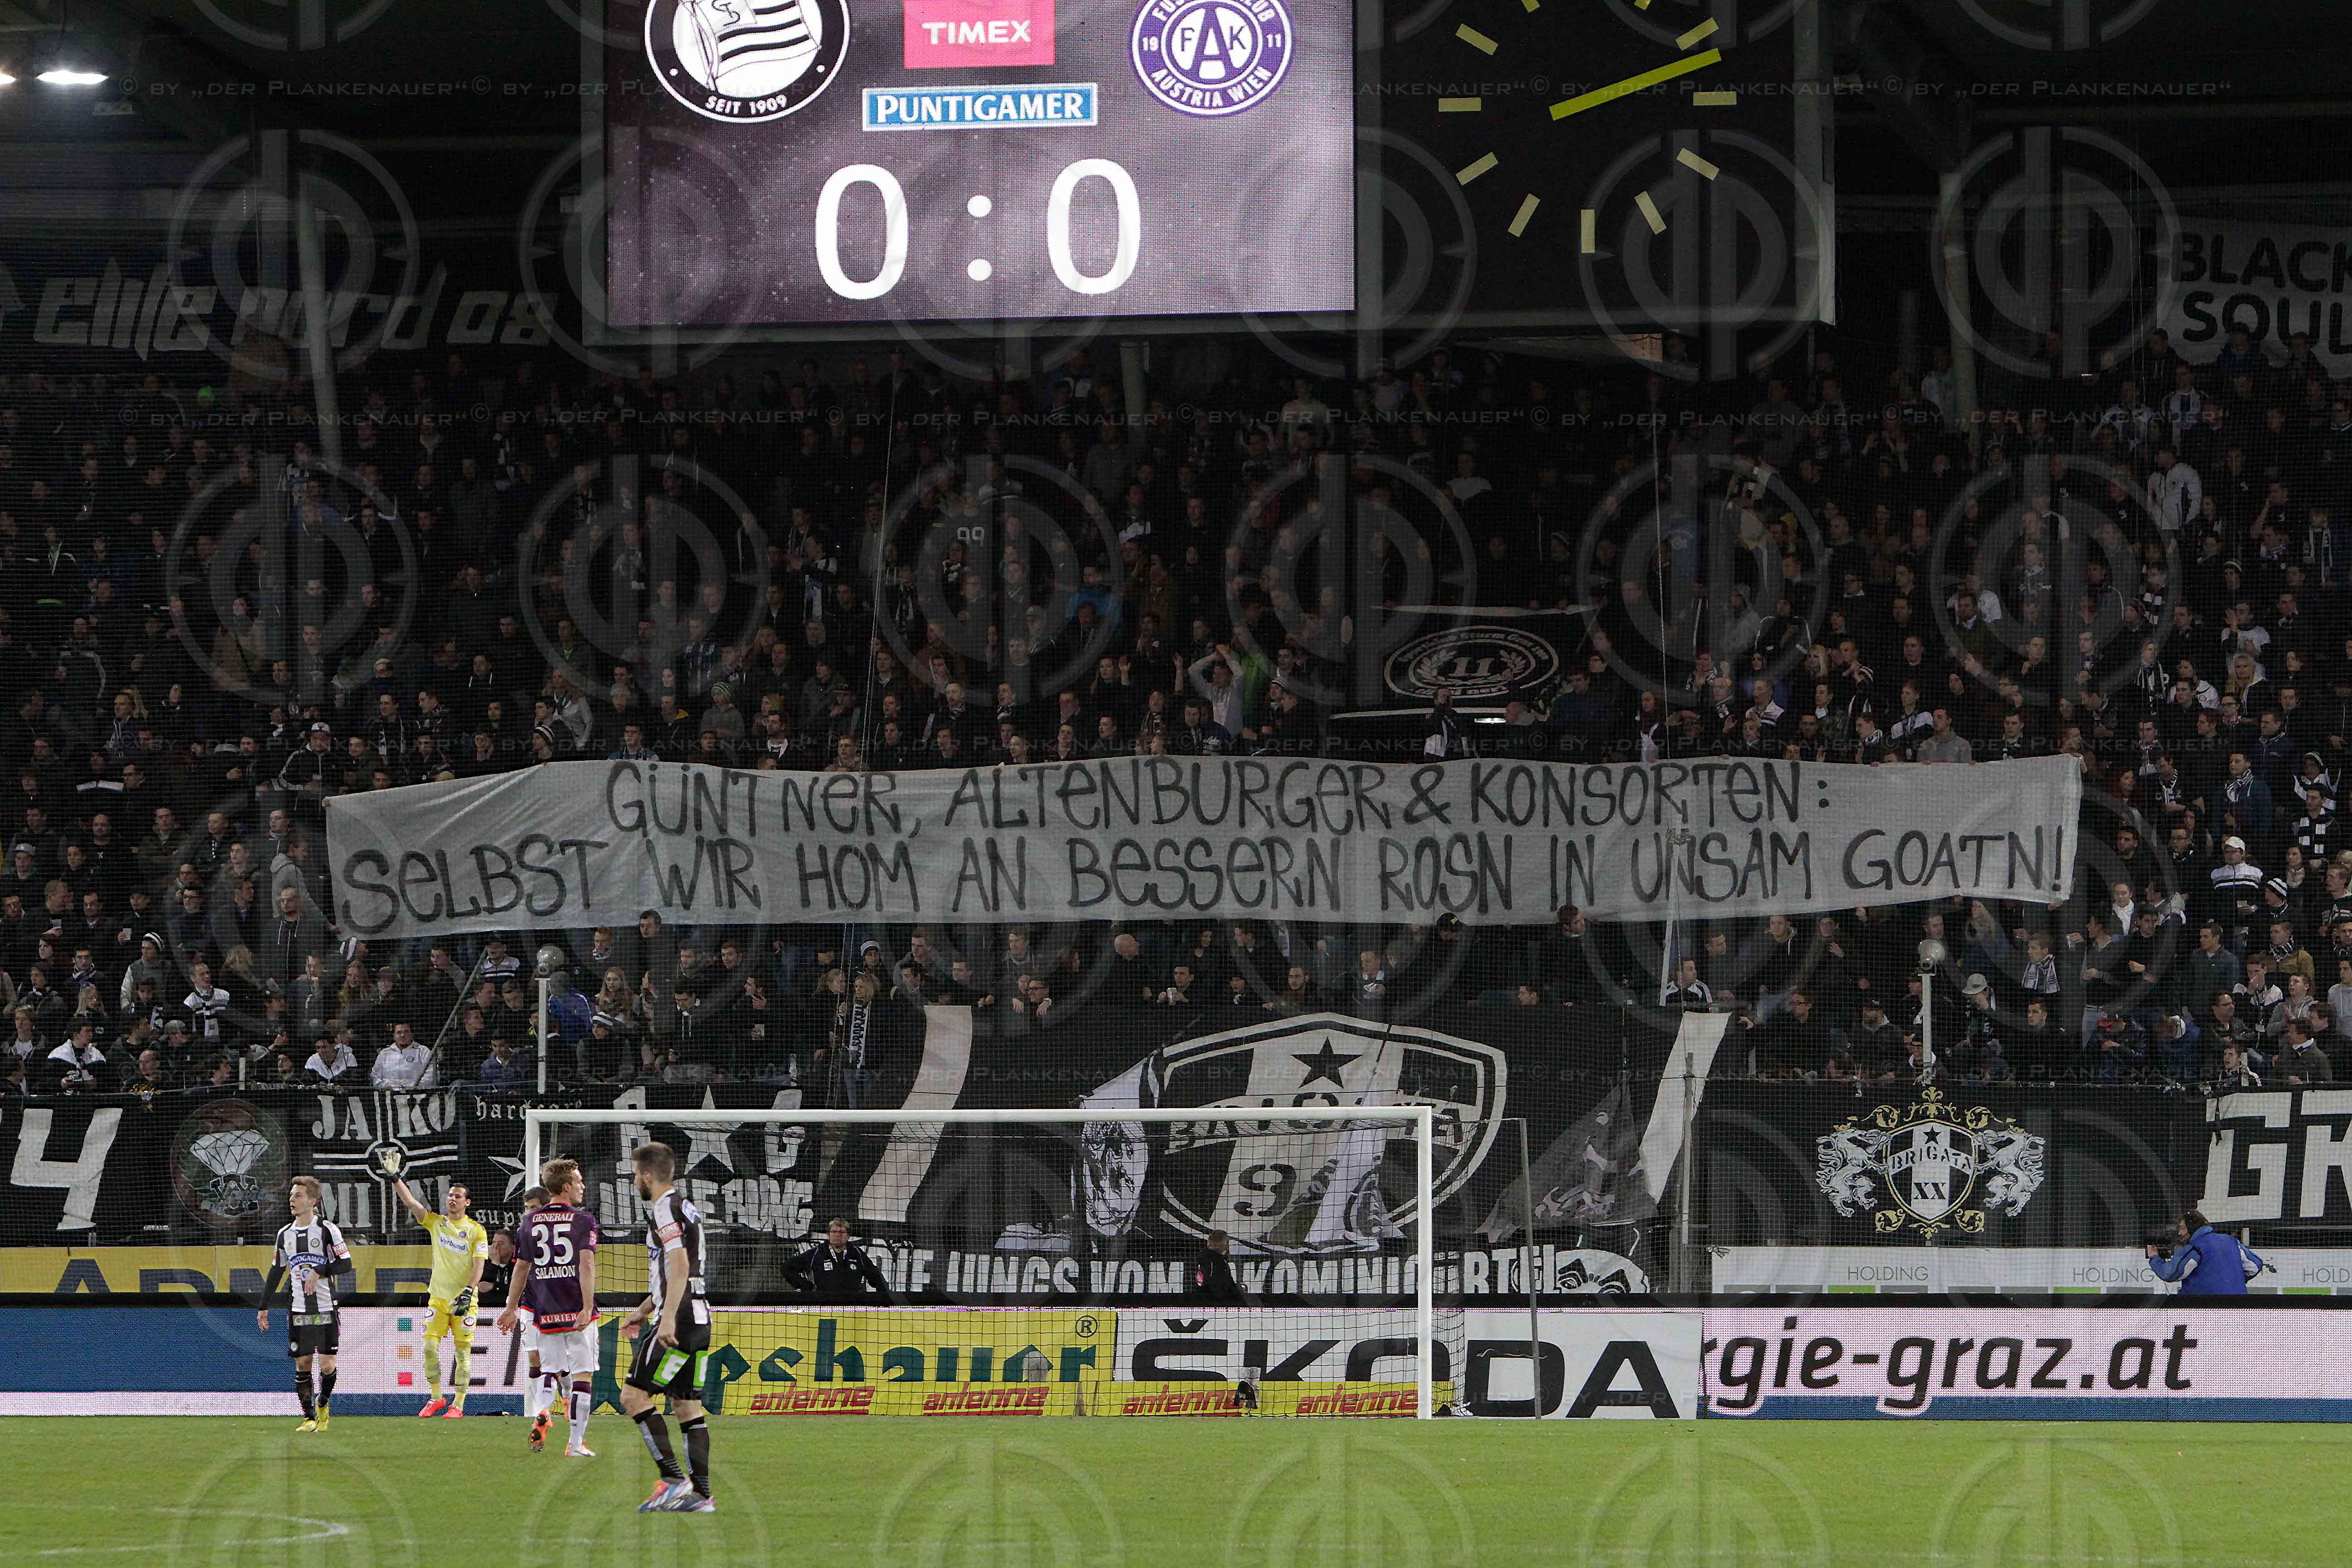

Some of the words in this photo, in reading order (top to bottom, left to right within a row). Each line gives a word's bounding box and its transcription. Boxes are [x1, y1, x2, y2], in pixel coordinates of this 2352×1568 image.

[922, 20, 1031, 44] TIMEX
[1266, 33, 1282, 48] 11
[1151, 68, 1223, 107] AUSTRIA
[1227, 66, 1272, 102] WIEN
[705, 94, 742, 115] SEIT
[749, 94, 788, 115] 1909
[876, 90, 1083, 123] PUNTIGAMER
[814, 163, 909, 300] 0
[1046, 158, 1142, 296] 0
[1403, 763, 1452, 826] &
[646, 836, 762, 909] WIR
[796, 838, 920, 913] HOM
[953, 836, 1026, 913] AN
[1379, 830, 1512, 911] ROSN
[1550, 832, 1595, 911] IN
[1631, 828, 1812, 902] UNSAM
[1843, 824, 2063, 892] GOATN!
[1892, 1146, 1972, 1169] BRIGATA
[1913, 1182, 1947, 1200] XX
[532, 1212, 573, 1223] GENERALI
[440, 1235, 466, 1250] Verbund
[531, 1223, 574, 1266] 35
[535, 1265, 576, 1280] SALAMON
[1090, 1259, 1184, 1293] VOM
[1847, 1265, 1929, 1282] HOLDING
[2073, 1267, 2155, 1283] HOLDING
[294, 1315, 328, 1325] GRAZ
[540, 1313, 578, 1323] KURIER
[750, 1381, 876, 1411] antenne
[923, 1382, 1050, 1411] antenne
